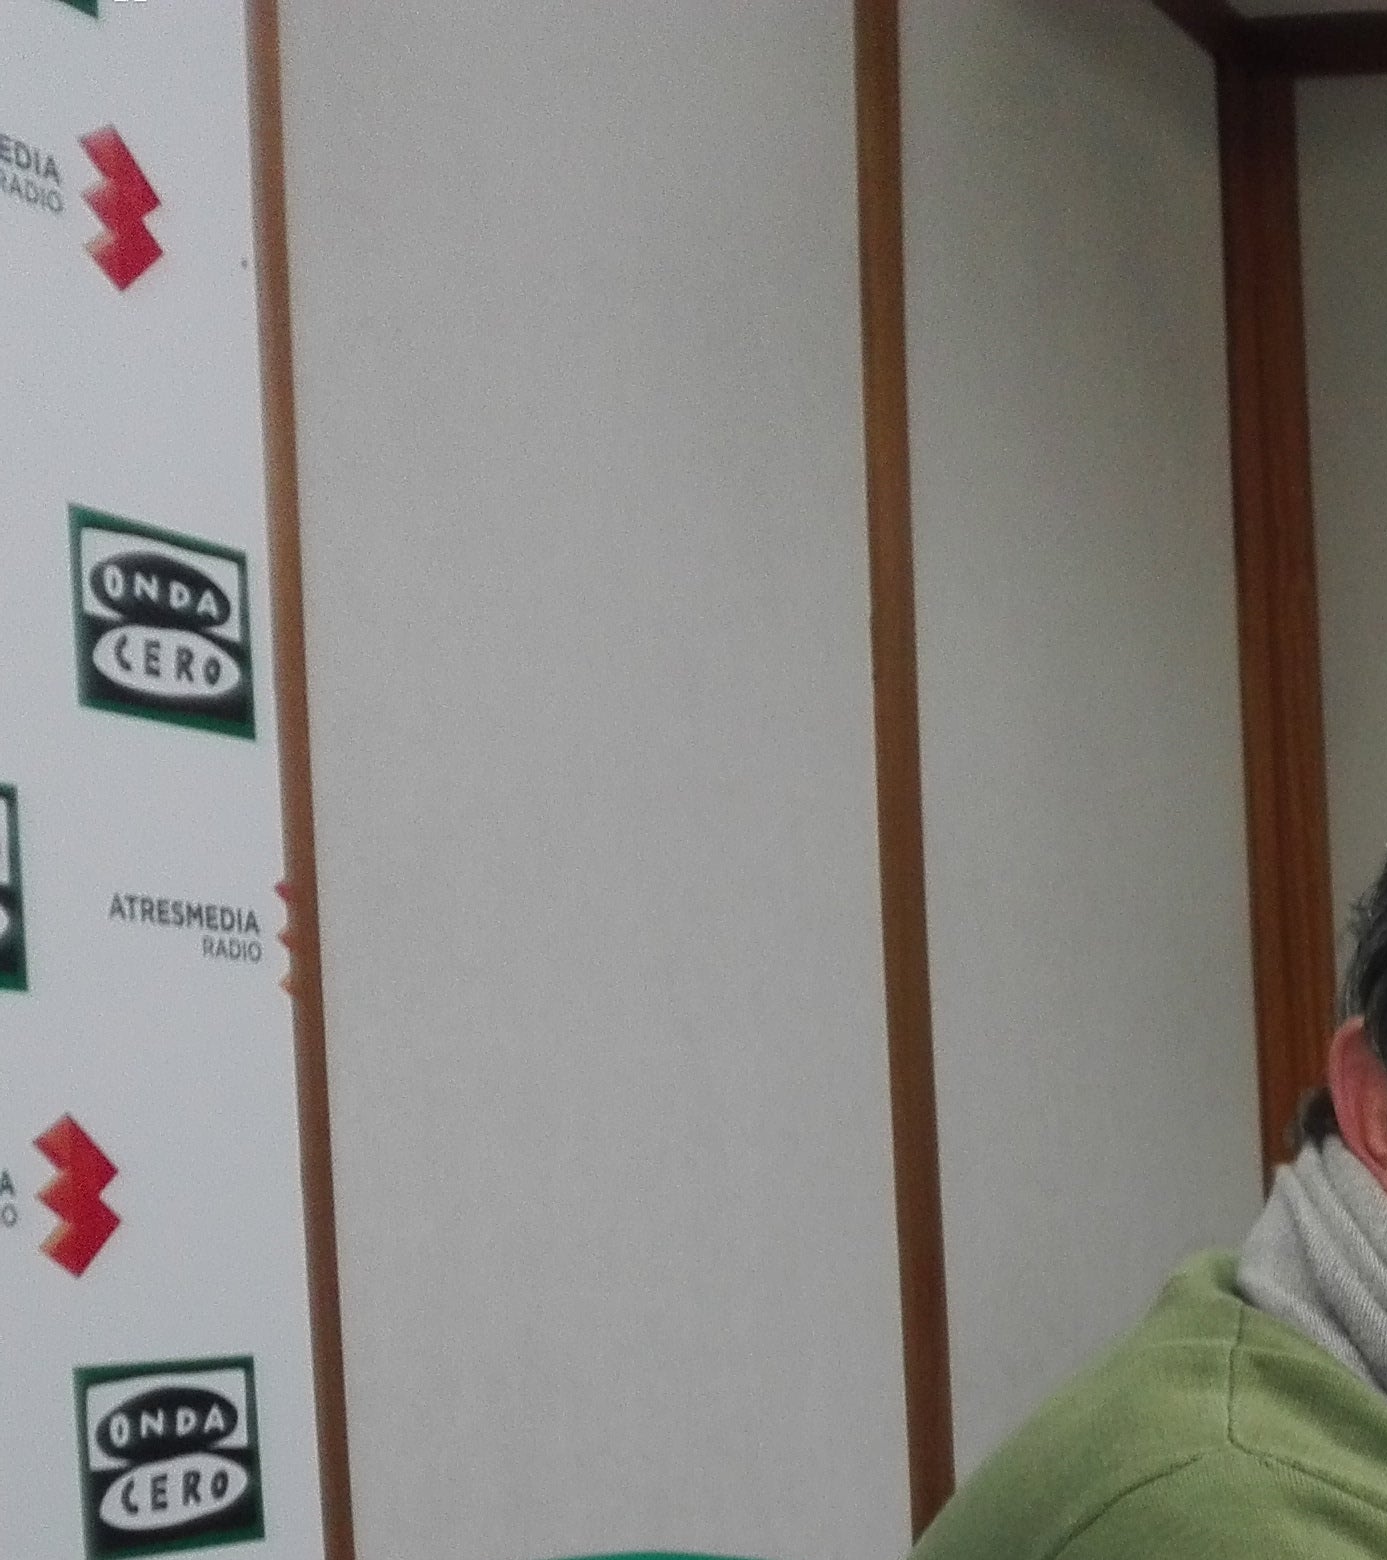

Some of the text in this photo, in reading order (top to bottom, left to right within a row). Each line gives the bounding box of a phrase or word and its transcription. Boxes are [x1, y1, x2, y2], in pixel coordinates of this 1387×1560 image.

[102, 565, 219, 621] ONDA
[114, 632, 221, 686] CERO
[108, 893, 261, 935] ATRESMEDIA
[202, 935, 263, 964] RADIO
[109, 1403, 225, 1448] ONDA
[121, 1469, 229, 1516] CERO
